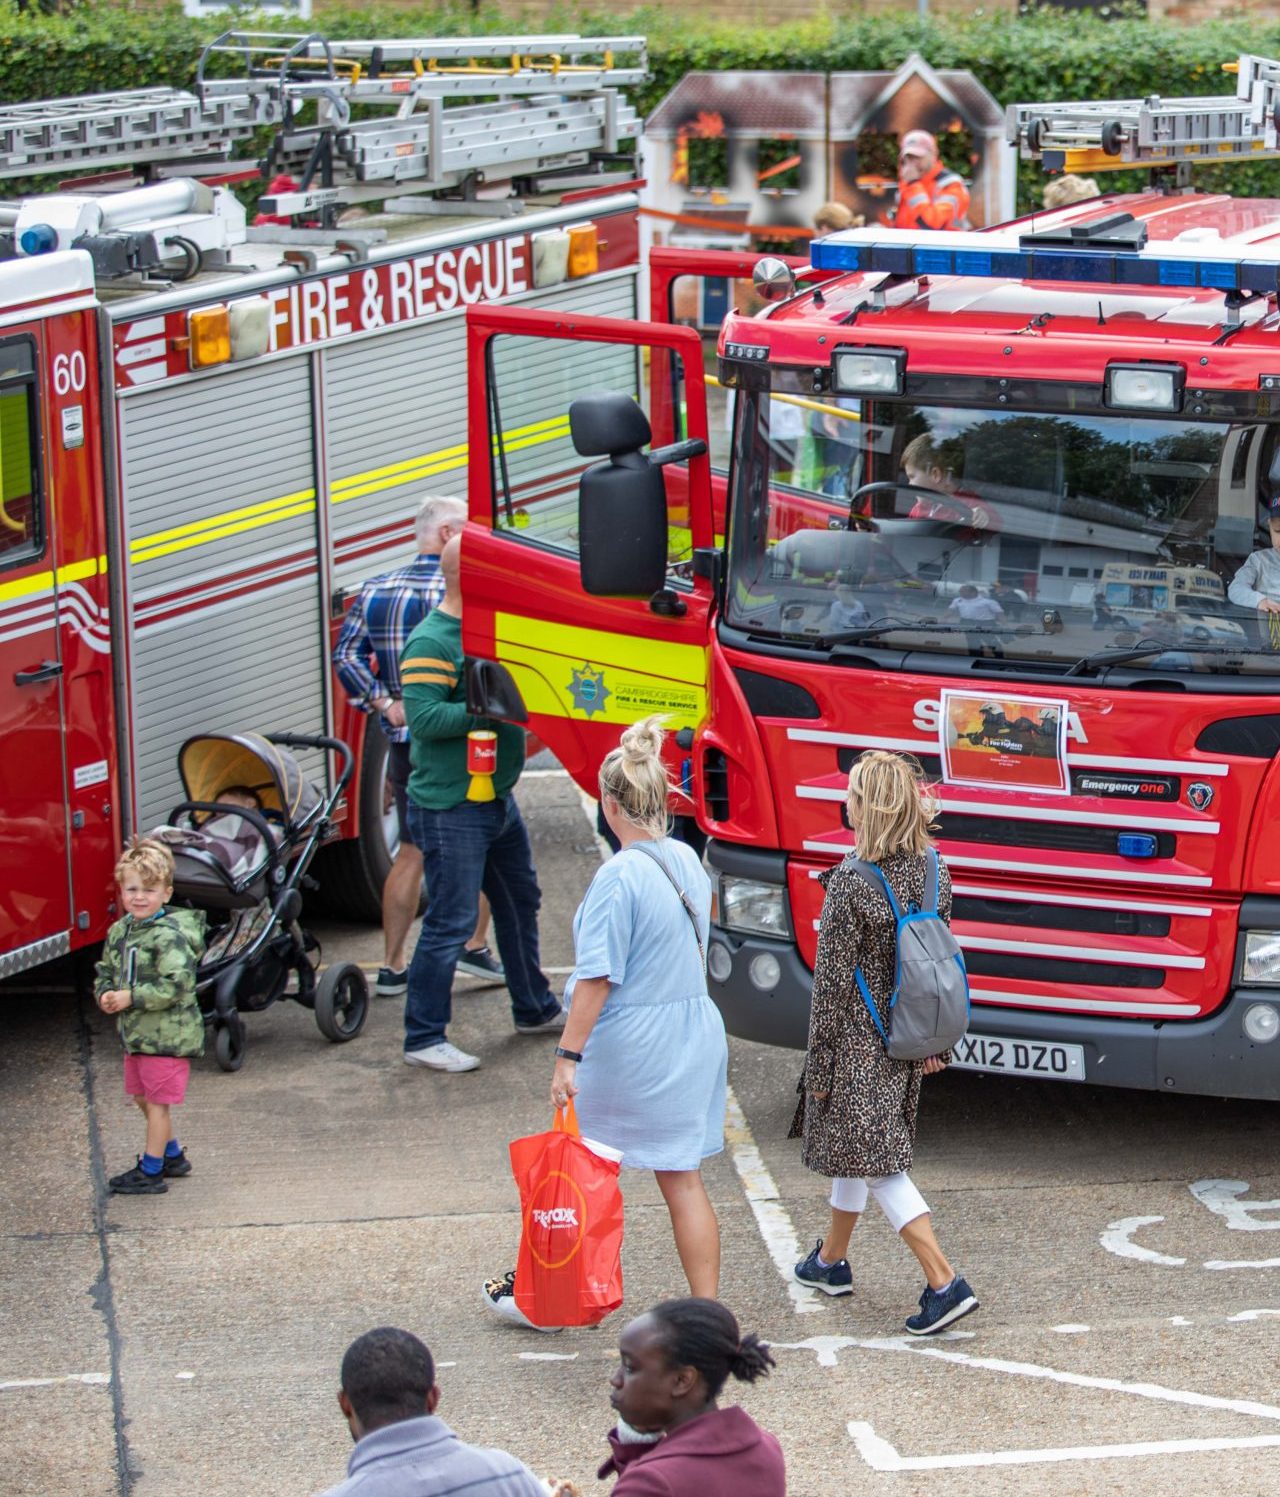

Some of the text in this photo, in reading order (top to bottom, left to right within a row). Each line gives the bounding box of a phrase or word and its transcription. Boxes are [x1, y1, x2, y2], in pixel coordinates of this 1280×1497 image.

[267, 234, 527, 351] FIRE & RESCUE
[53, 350, 86, 395] 60
[615, 685, 697, 702] CAMBRIDGESHIRE
[616, 695, 630, 703] FIRE
[639, 698, 666, 706] RESCUE
[668, 700, 697, 709] SERVICE
[1013, 1043, 1067, 1073] DZO
